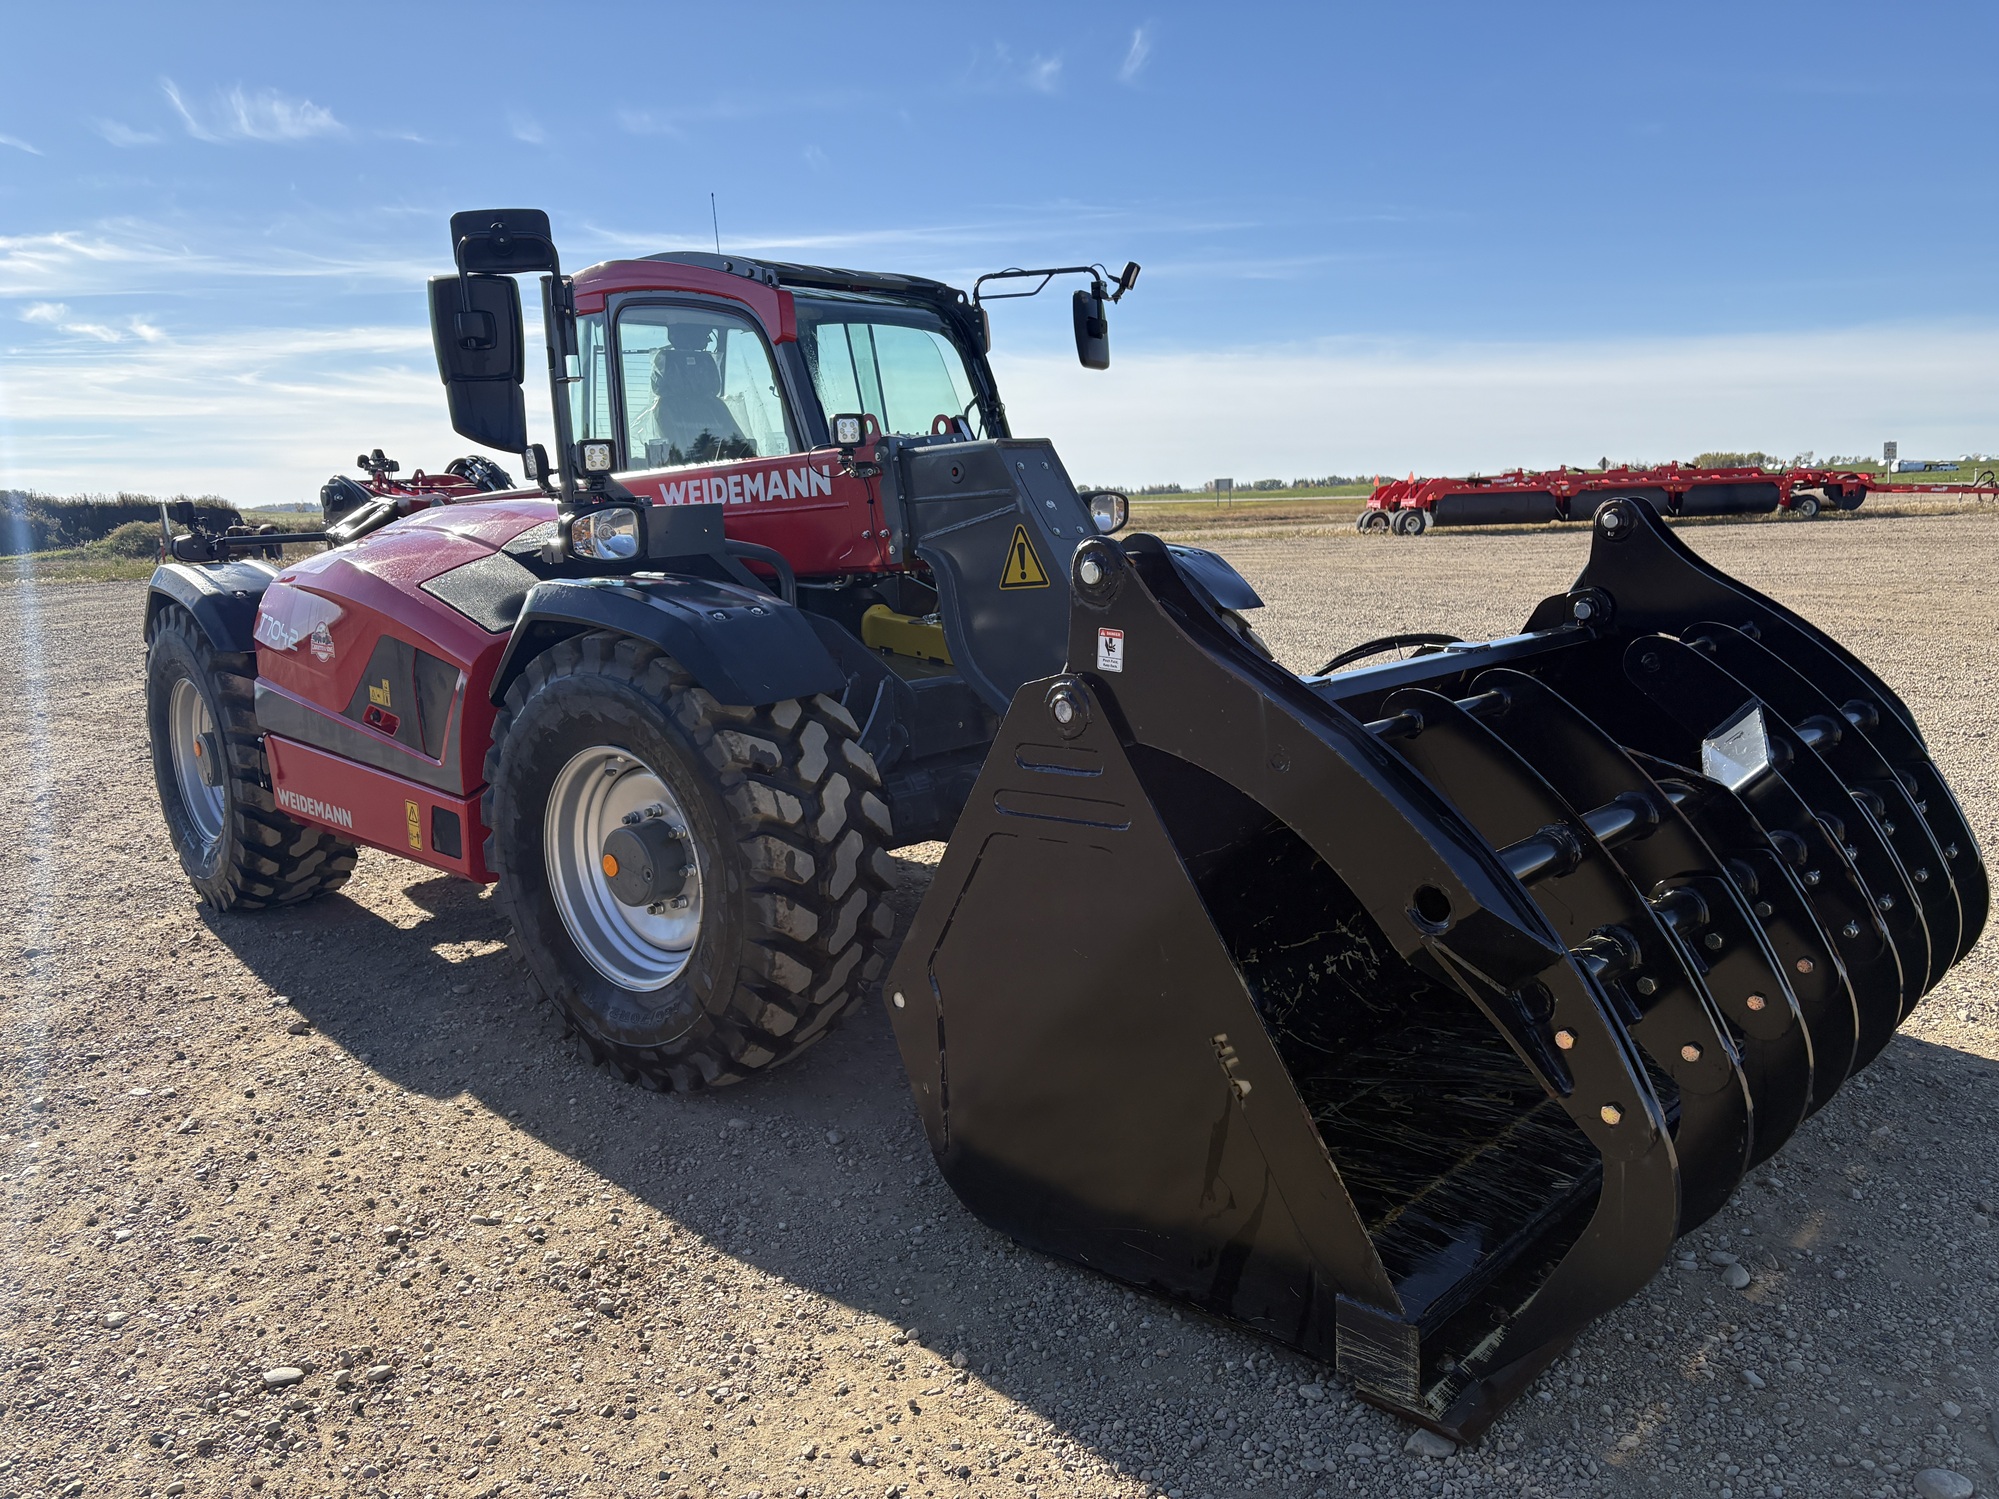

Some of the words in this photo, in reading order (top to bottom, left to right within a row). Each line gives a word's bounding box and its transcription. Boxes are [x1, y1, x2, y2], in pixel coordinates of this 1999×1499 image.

[659, 465, 832, 506] WEIDEMANN
[259, 612, 299, 652] T7042
[277, 787, 353, 829] WEIDEMANN
